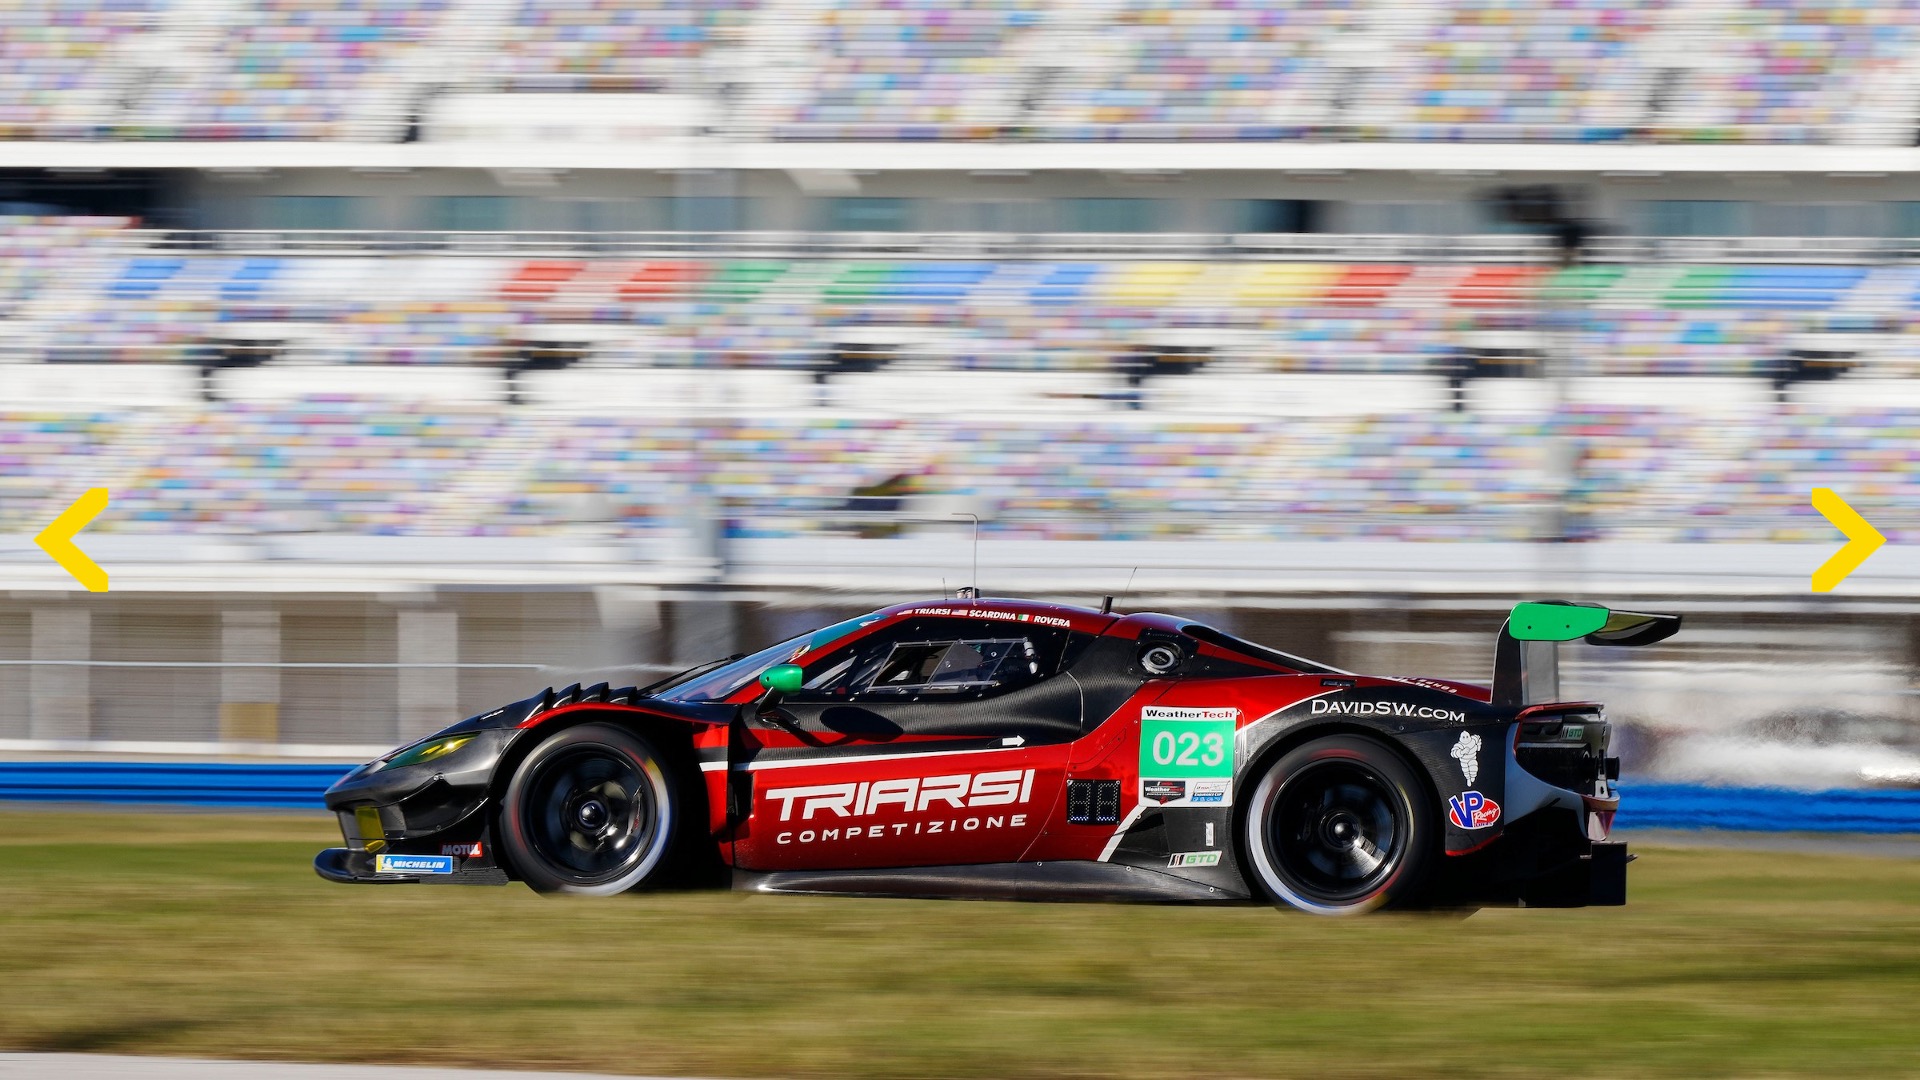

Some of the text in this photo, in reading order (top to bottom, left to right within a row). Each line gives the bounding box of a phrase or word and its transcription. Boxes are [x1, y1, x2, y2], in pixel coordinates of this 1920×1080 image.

[915, 608, 1071, 627] TRIARSI SCARDINA ROVERA
[1146, 709, 1233, 718] WeatherTech
[1153, 730, 1224, 767] 023
[765, 768, 1036, 821] TRIARSI
[1449, 791, 1485, 828] VP
[776, 813, 1028, 845] COMPETIZIONE
[441, 843, 481, 856] MOTUL
[392, 860, 446, 869] MICHELIN
[1185, 854, 1218, 865] GTD
